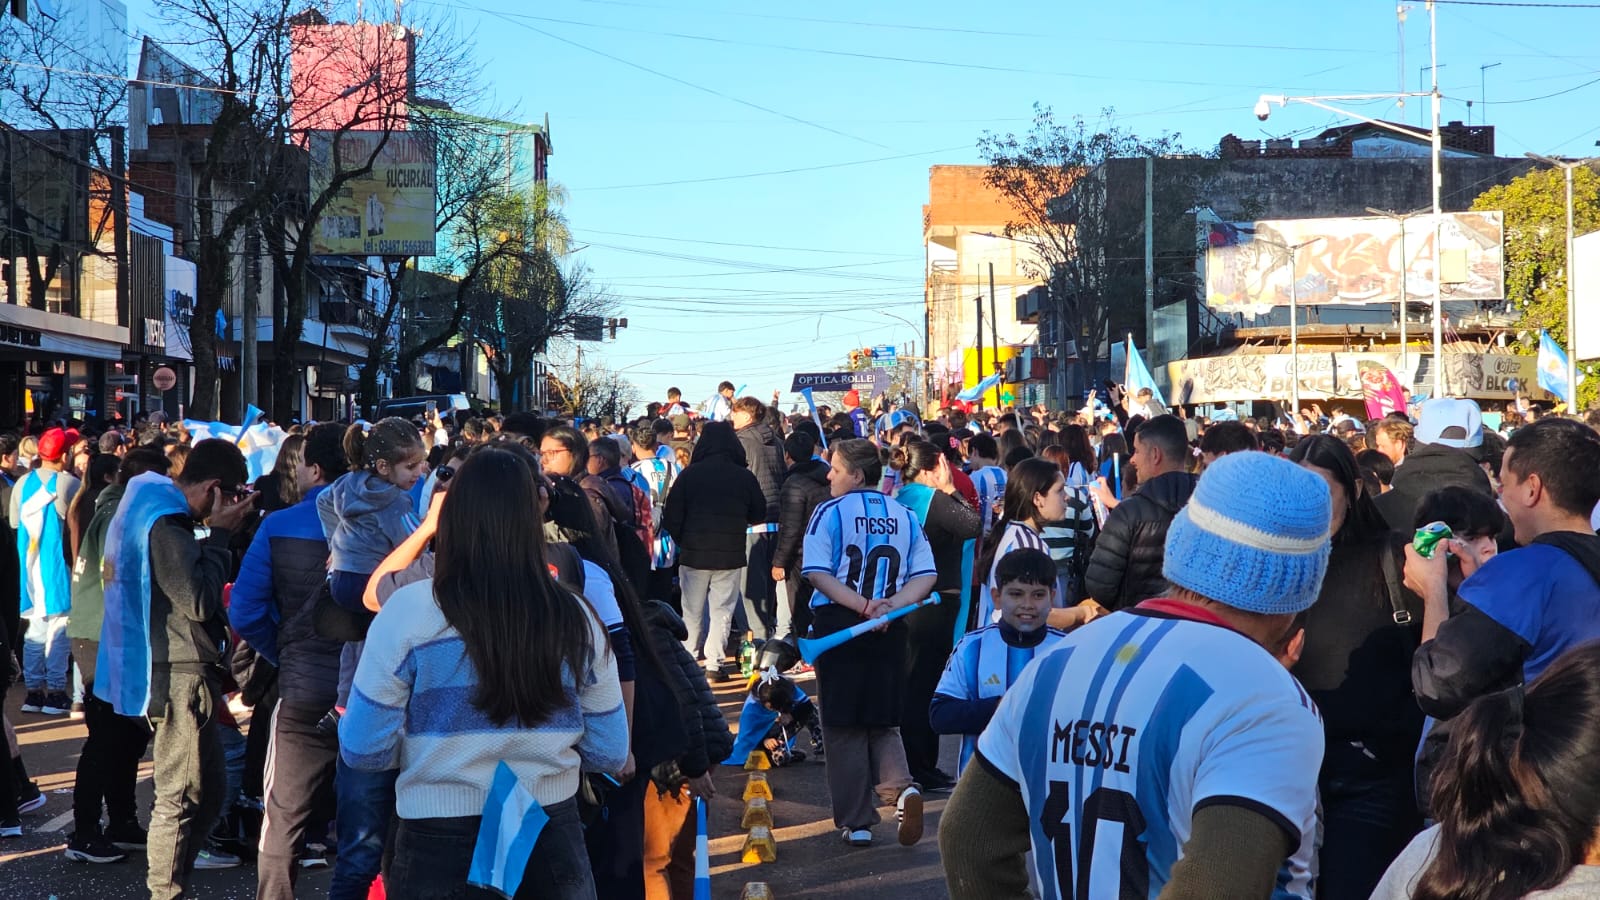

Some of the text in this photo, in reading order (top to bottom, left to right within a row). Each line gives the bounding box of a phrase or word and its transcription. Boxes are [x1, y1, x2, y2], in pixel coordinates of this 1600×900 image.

[386, 168, 433, 188] SUCURSAL
[798, 375, 839, 385] OPTICA
[855, 516, 898, 535] MESSI
[846, 544, 901, 600] 10
[1052, 718, 1136, 773] MESSI
[1040, 780, 1150, 900] 10
